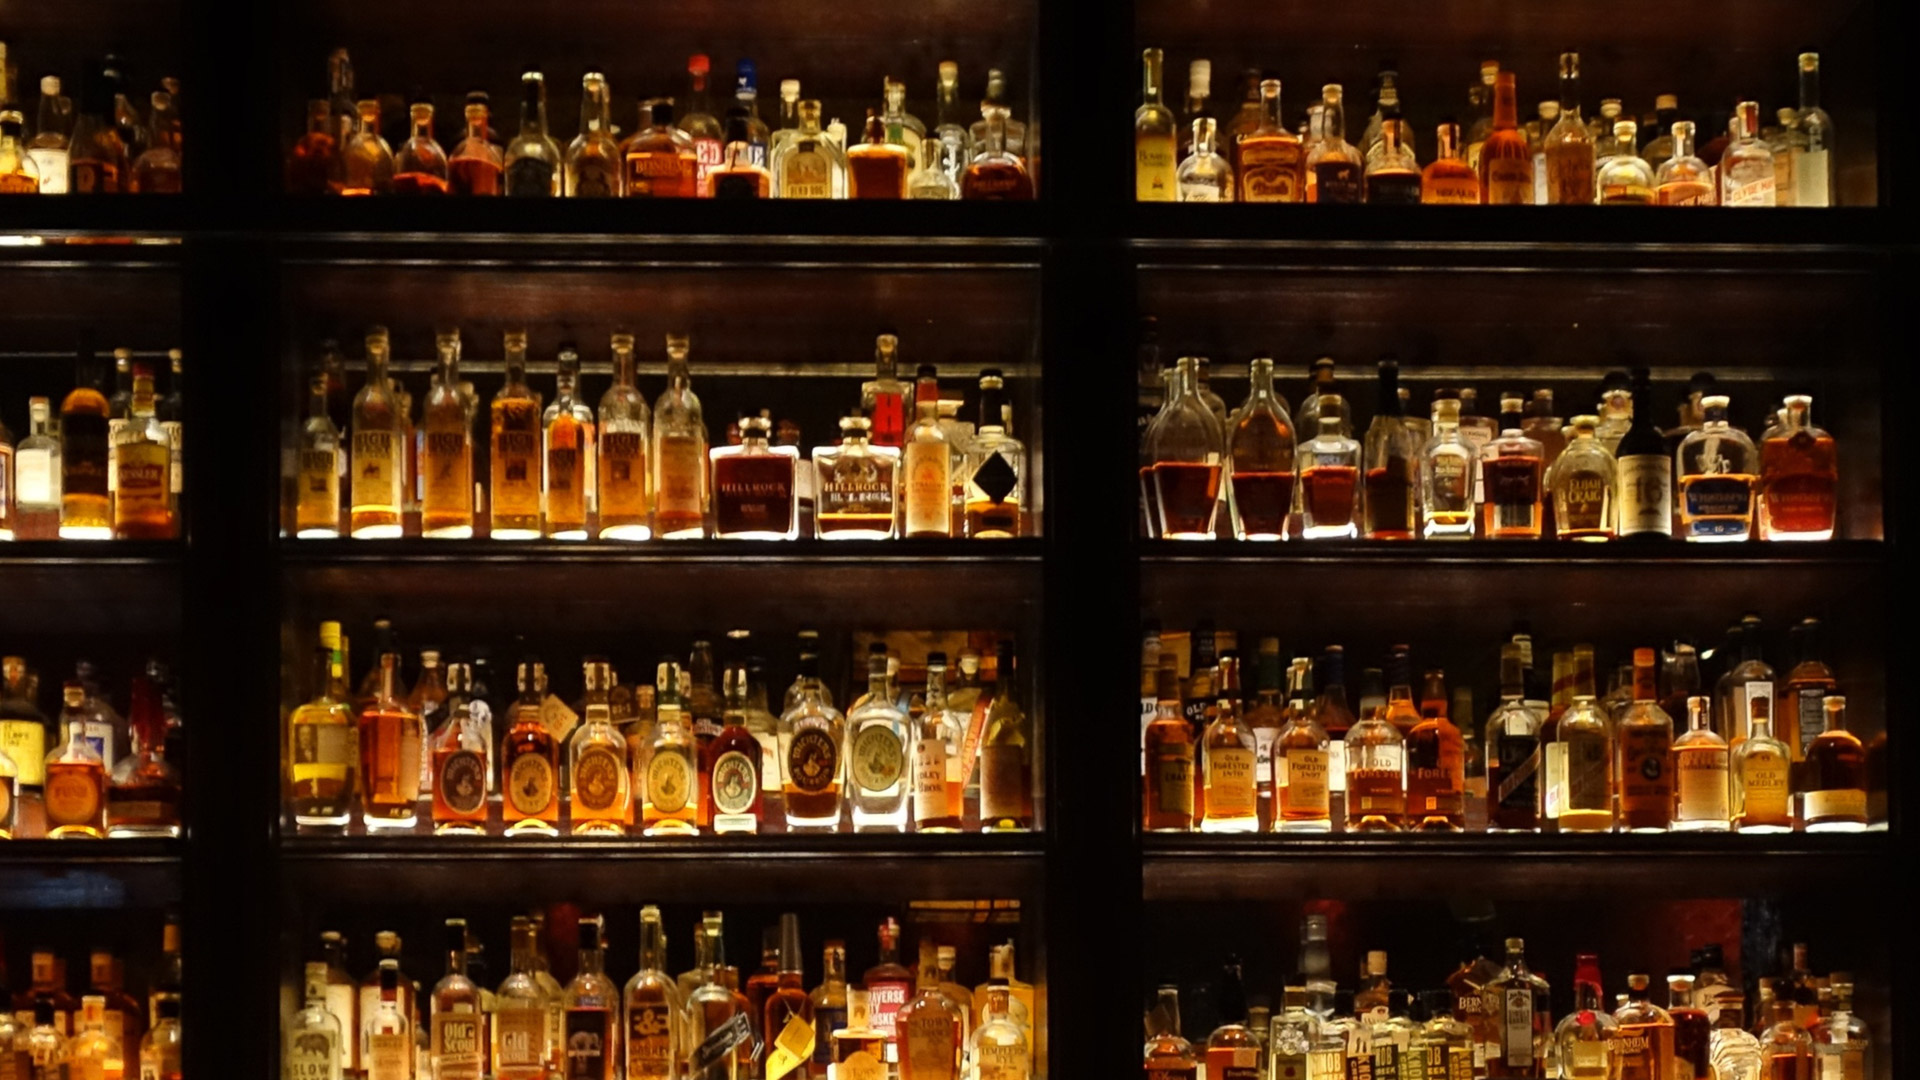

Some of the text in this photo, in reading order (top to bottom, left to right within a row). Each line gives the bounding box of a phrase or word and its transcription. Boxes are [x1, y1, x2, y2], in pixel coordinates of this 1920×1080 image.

[721, 484, 786, 493] HILLROCK
[824, 482, 888, 491] HILLROCK
[1570, 479, 1601, 489] ELIJAH
[1568, 490, 1601, 503] CRAIG
[1372, 759, 1391, 767] OLD
[293, 1064, 330, 1075] SLOW
